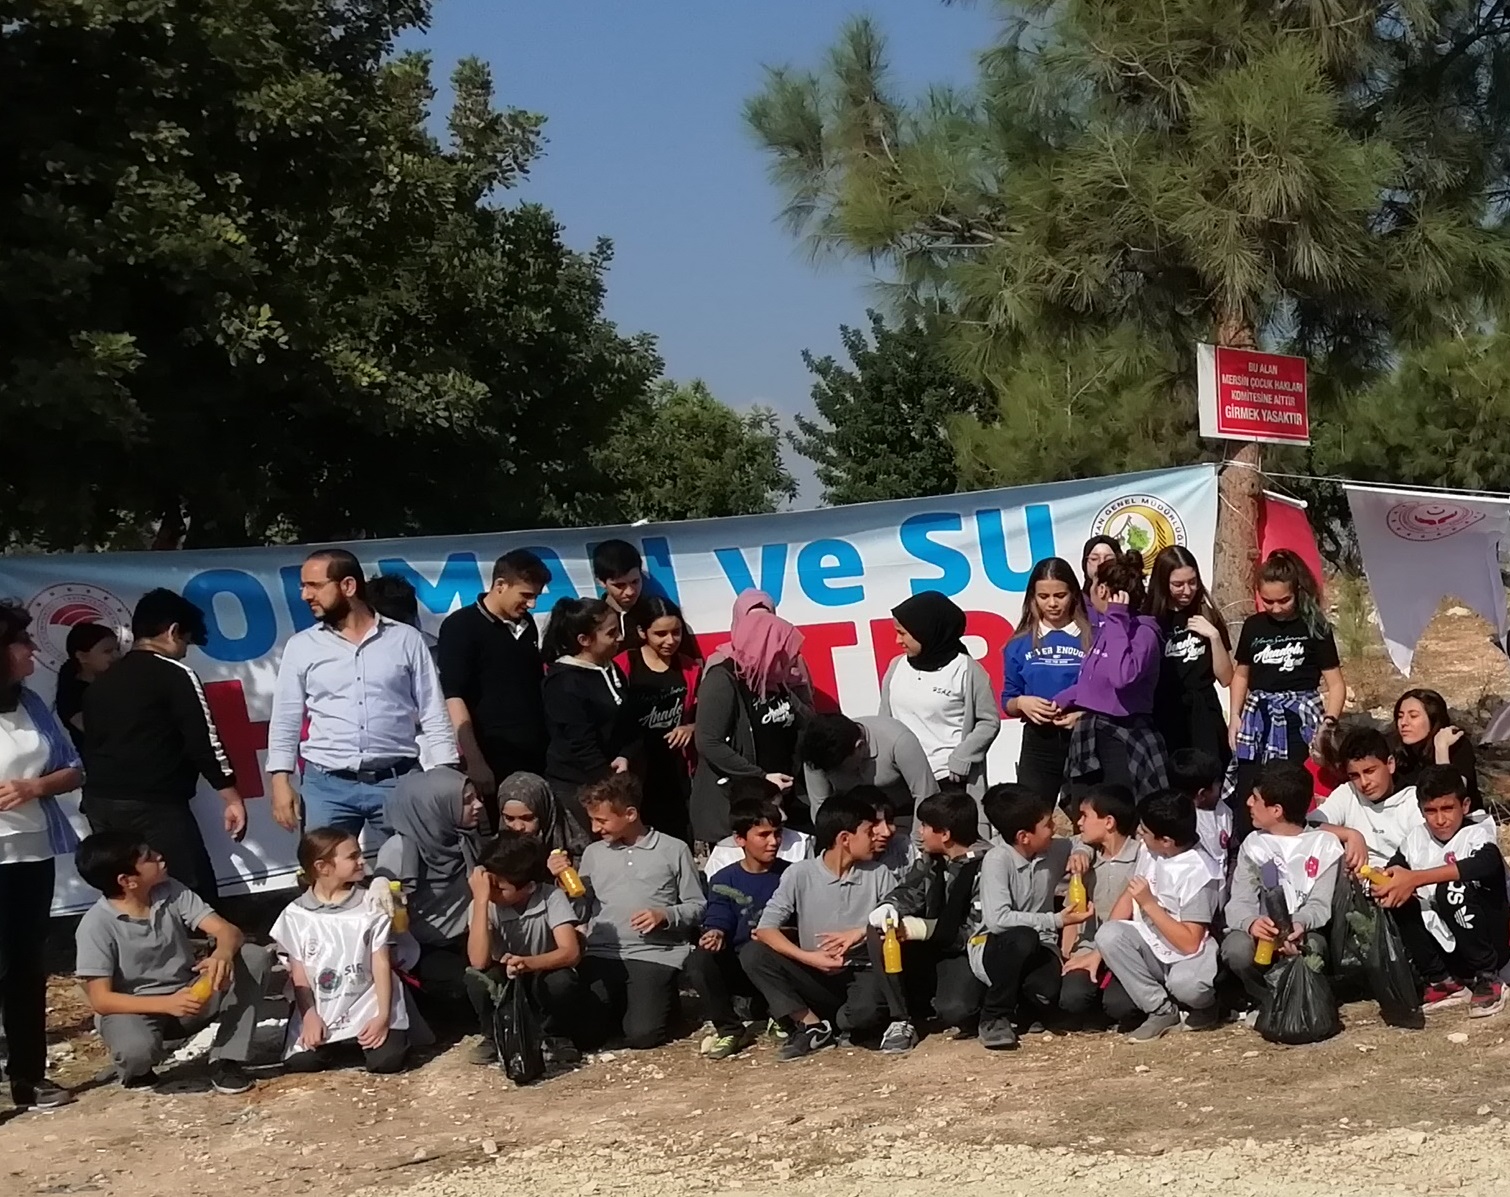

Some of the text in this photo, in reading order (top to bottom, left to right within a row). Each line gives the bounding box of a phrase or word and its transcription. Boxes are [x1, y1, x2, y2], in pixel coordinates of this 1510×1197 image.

[1248, 361, 1278, 375] BU ALAN
[1221, 373, 1304, 393] MERSİN ÇOCUK HAKLARI
[1225, 402, 1303, 426] GİRMEK YASAKTIR
[1105, 497, 1137, 516] GENEL
[714, 539, 867, 608] ve
